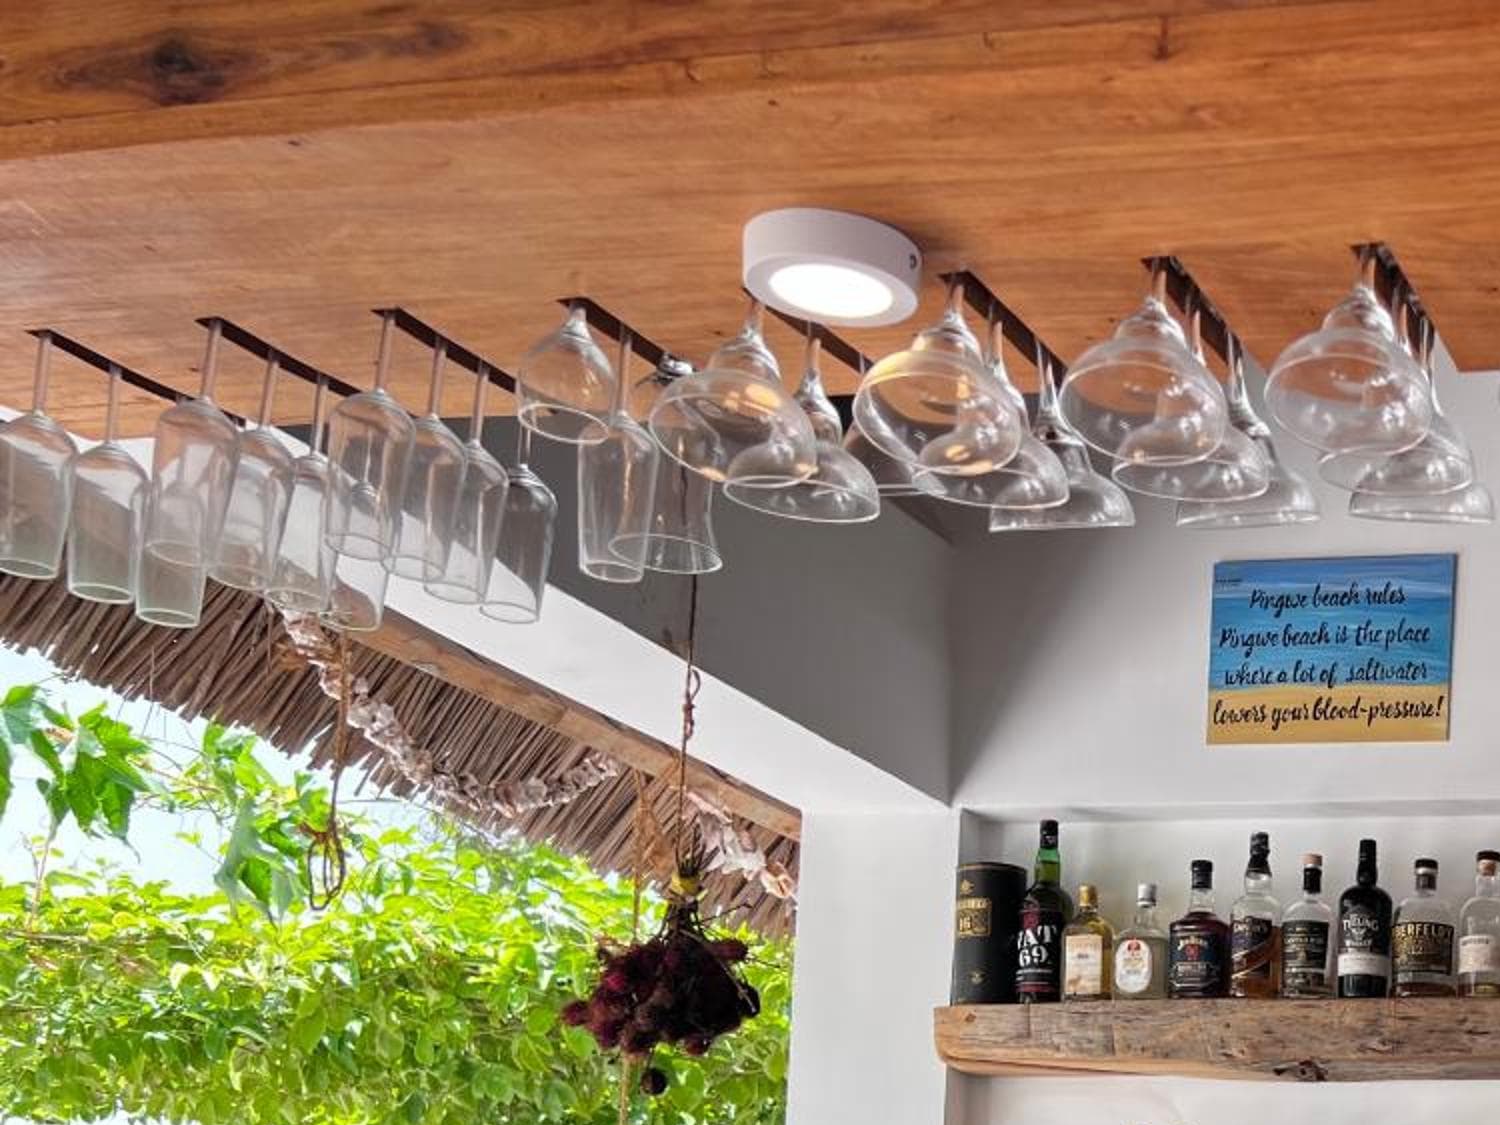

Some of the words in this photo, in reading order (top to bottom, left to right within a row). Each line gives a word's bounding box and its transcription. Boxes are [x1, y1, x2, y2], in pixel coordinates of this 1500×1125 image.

[1249, 588, 1308, 618] Pingwe
[1312, 582, 1360, 609] beach
[1365, 581, 1405, 605] rules
[1219, 627, 1278, 658] Pingwe
[1282, 622, 1330, 648] beach
[1335, 624, 1347, 644] is
[1355, 619, 1379, 646] the
[1384, 618, 1430, 652] place
[1224, 662, 1273, 686] where
[1276, 670, 1290, 684] a
[1293, 659, 1316, 683] lot
[1319, 662, 1338, 689] of
[1346, 657, 1428, 683] saltwater
[1213, 699, 1267, 725] lowers
[1271, 703, 1309, 731] your
[1312, 695, 1445, 727] blood-pressure!
[1019, 945, 1050, 970] 69
